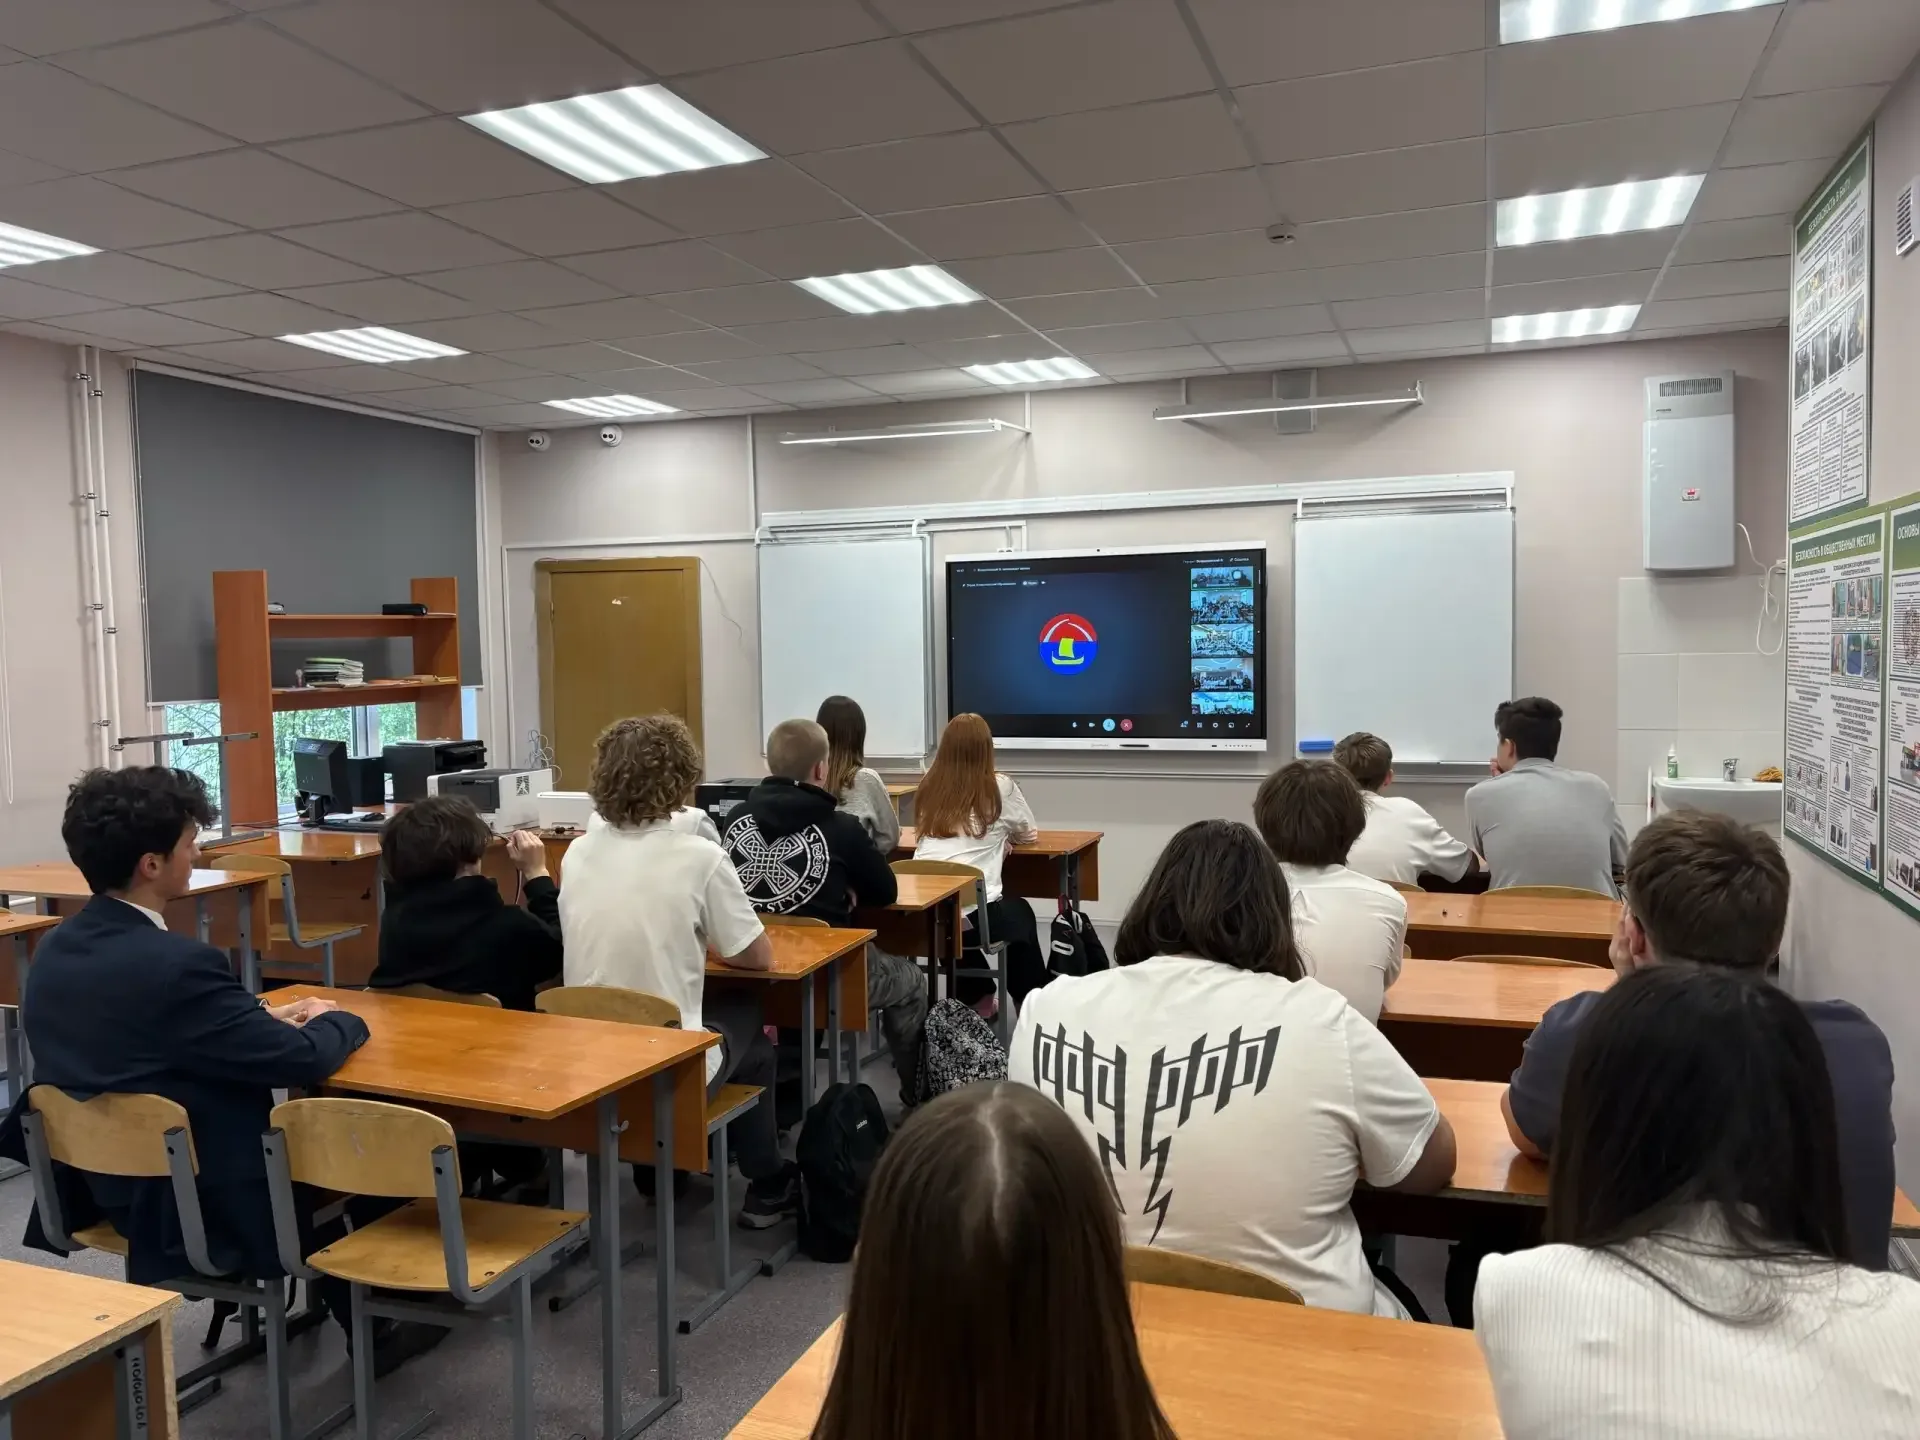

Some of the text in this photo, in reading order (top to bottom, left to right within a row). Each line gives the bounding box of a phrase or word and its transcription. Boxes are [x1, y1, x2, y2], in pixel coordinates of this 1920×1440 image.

[1897, 522, 1920, 540] ОСНОВЫ
[1823, 538, 1856, 556] ОБЩЕСТВЕННЫХ
[1856, 532, 1876, 549] МЕСТАХ
[766, 879, 817, 914] STYLE
